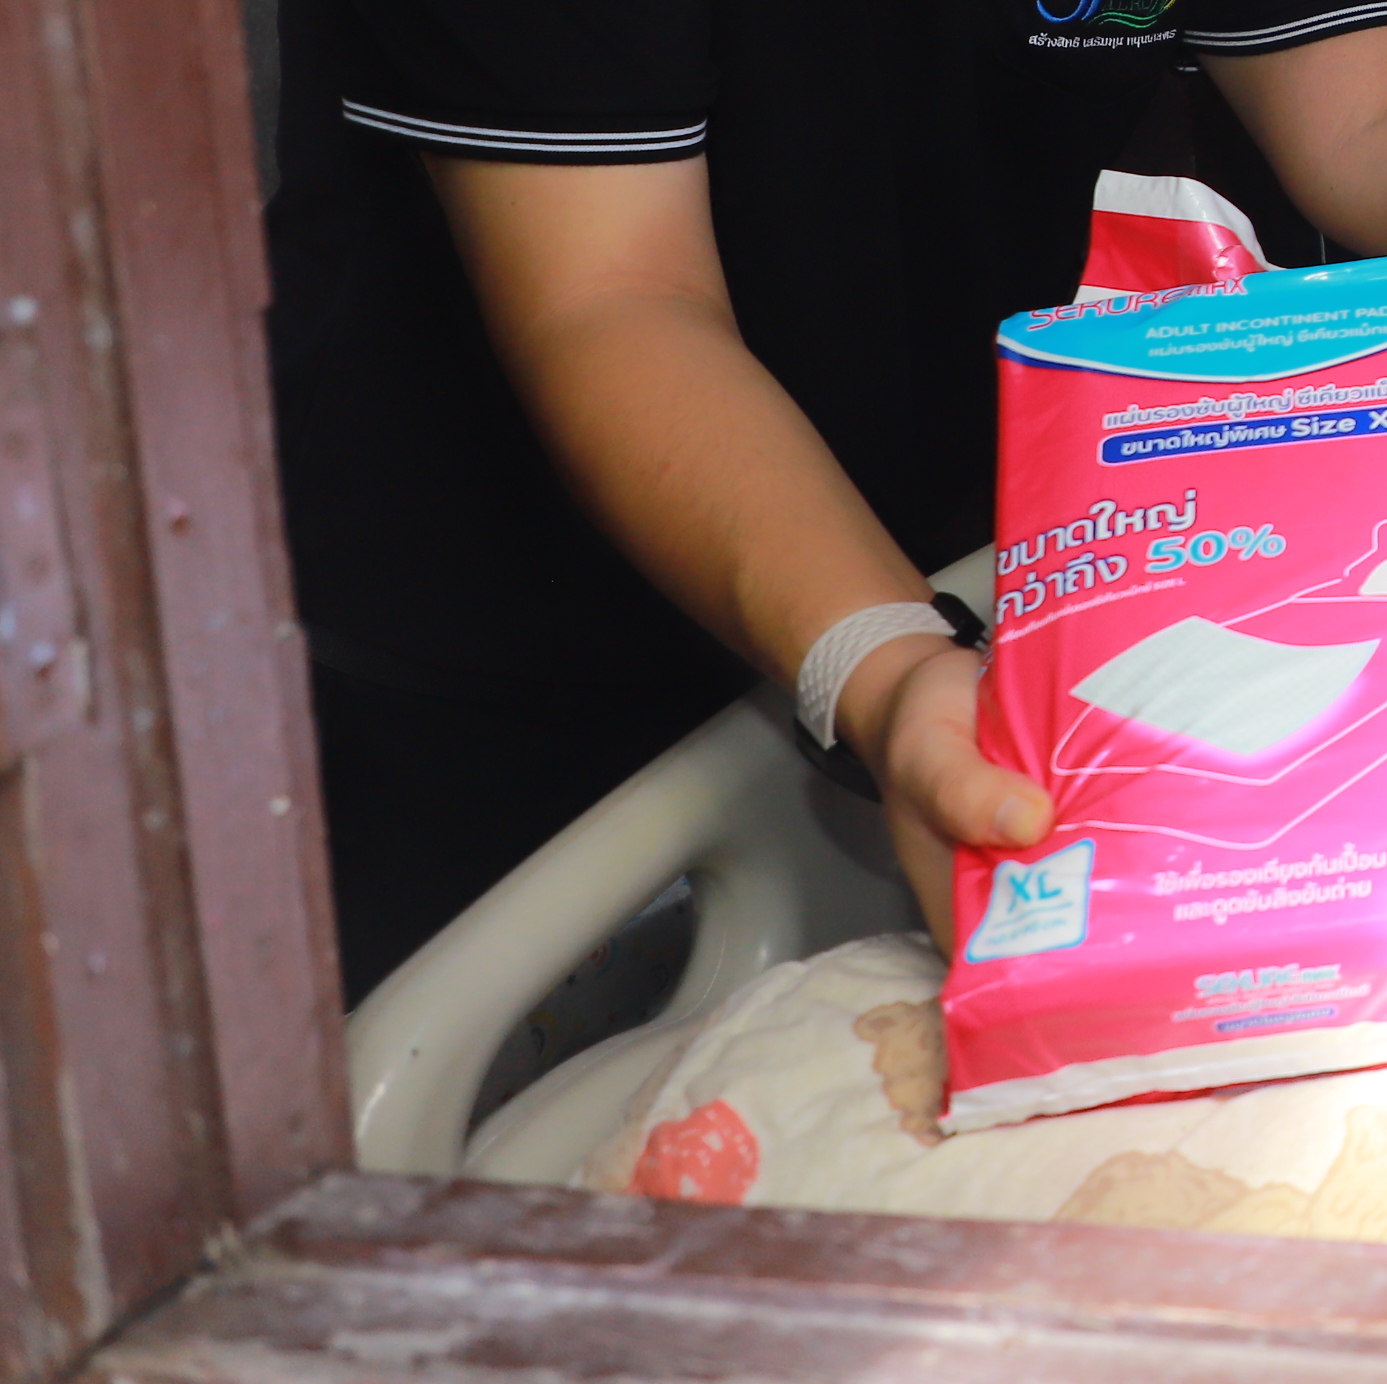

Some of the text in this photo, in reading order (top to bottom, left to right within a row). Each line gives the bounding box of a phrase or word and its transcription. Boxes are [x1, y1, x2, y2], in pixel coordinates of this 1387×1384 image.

[1146, 323, 1210, 339] ADULT
[1216, 310, 1350, 335] INCONTINENT
[1120, 422, 1287, 456] ขนาดใหญ่พิเศษ
[1291, 416, 1356, 436] Size
[997, 489, 1197, 575] ขนาดใหญ่
[996, 552, 1128, 624] กว่าถึง
[1146, 523, 1287, 573] 50%
[1008, 870, 1063, 914] XL
